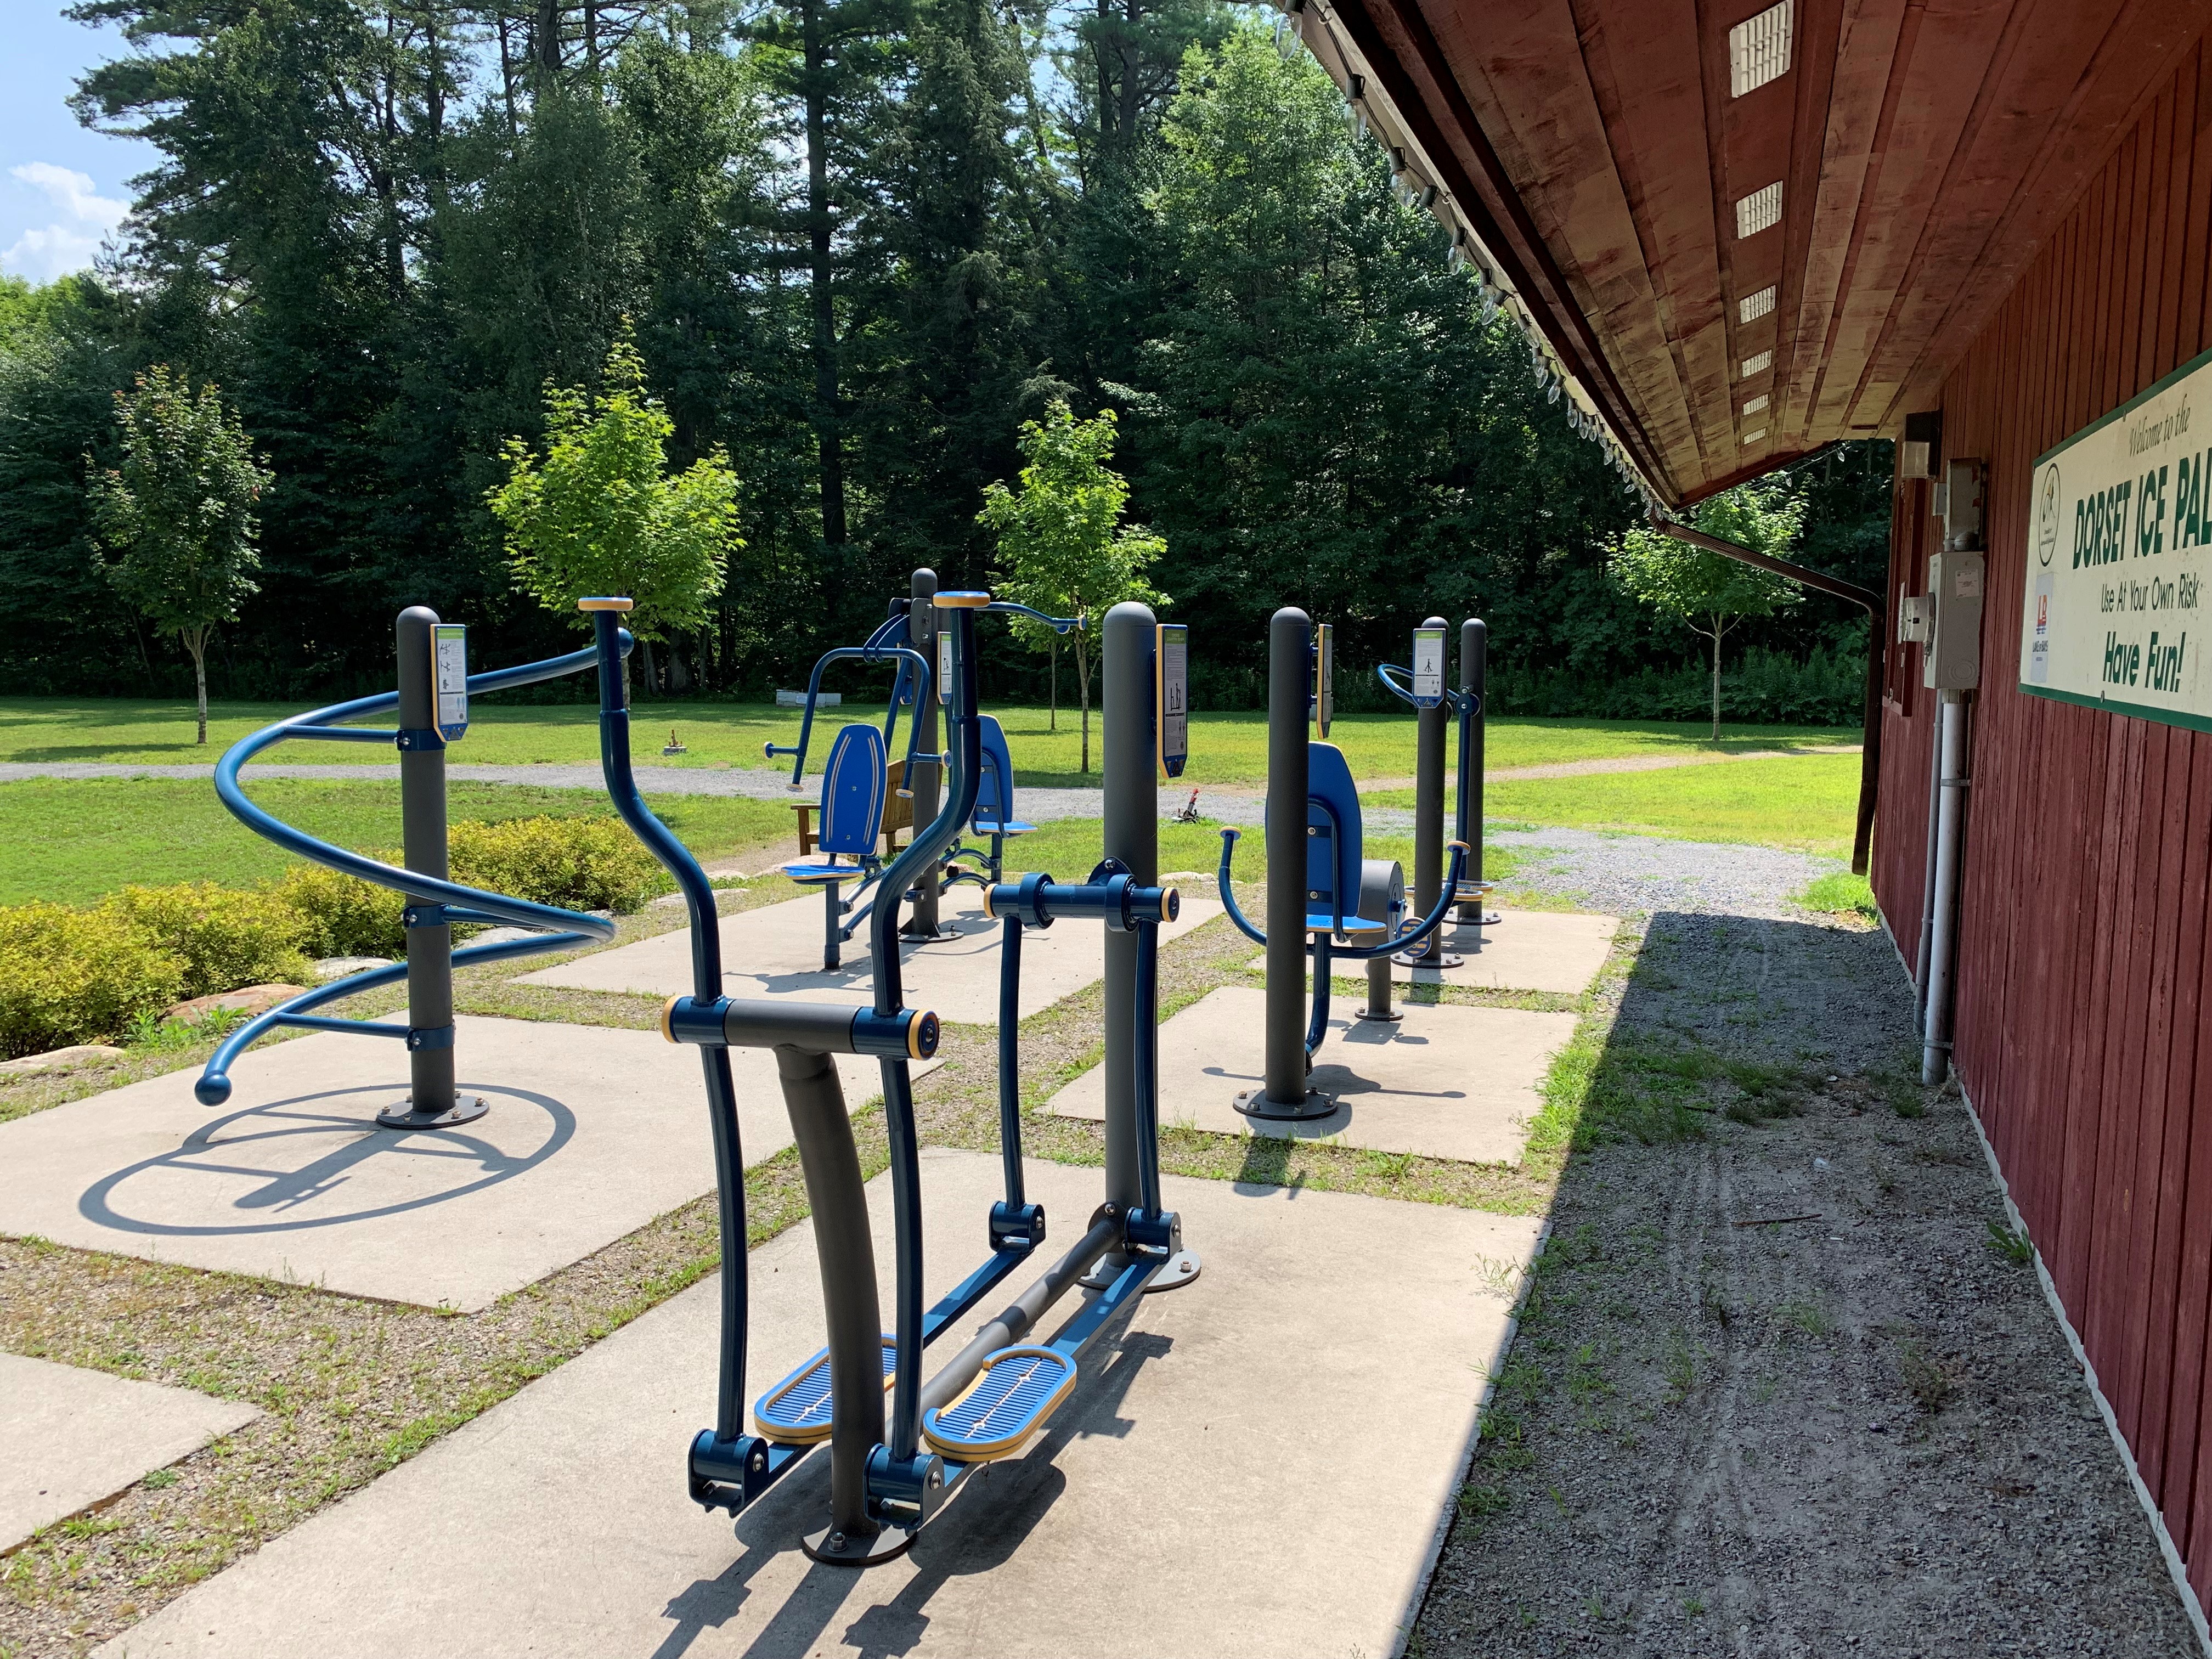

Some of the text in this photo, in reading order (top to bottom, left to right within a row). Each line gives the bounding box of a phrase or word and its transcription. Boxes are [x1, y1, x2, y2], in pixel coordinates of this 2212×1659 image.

[2130, 393, 2191, 458] Welcome to the
[2073, 479, 2132, 569] DORSET
[2134, 465, 2168, 557] ICE
[2101, 572, 2199, 613] Use At Your Own Risk
[2103, 631, 2186, 692] Have Fun!
